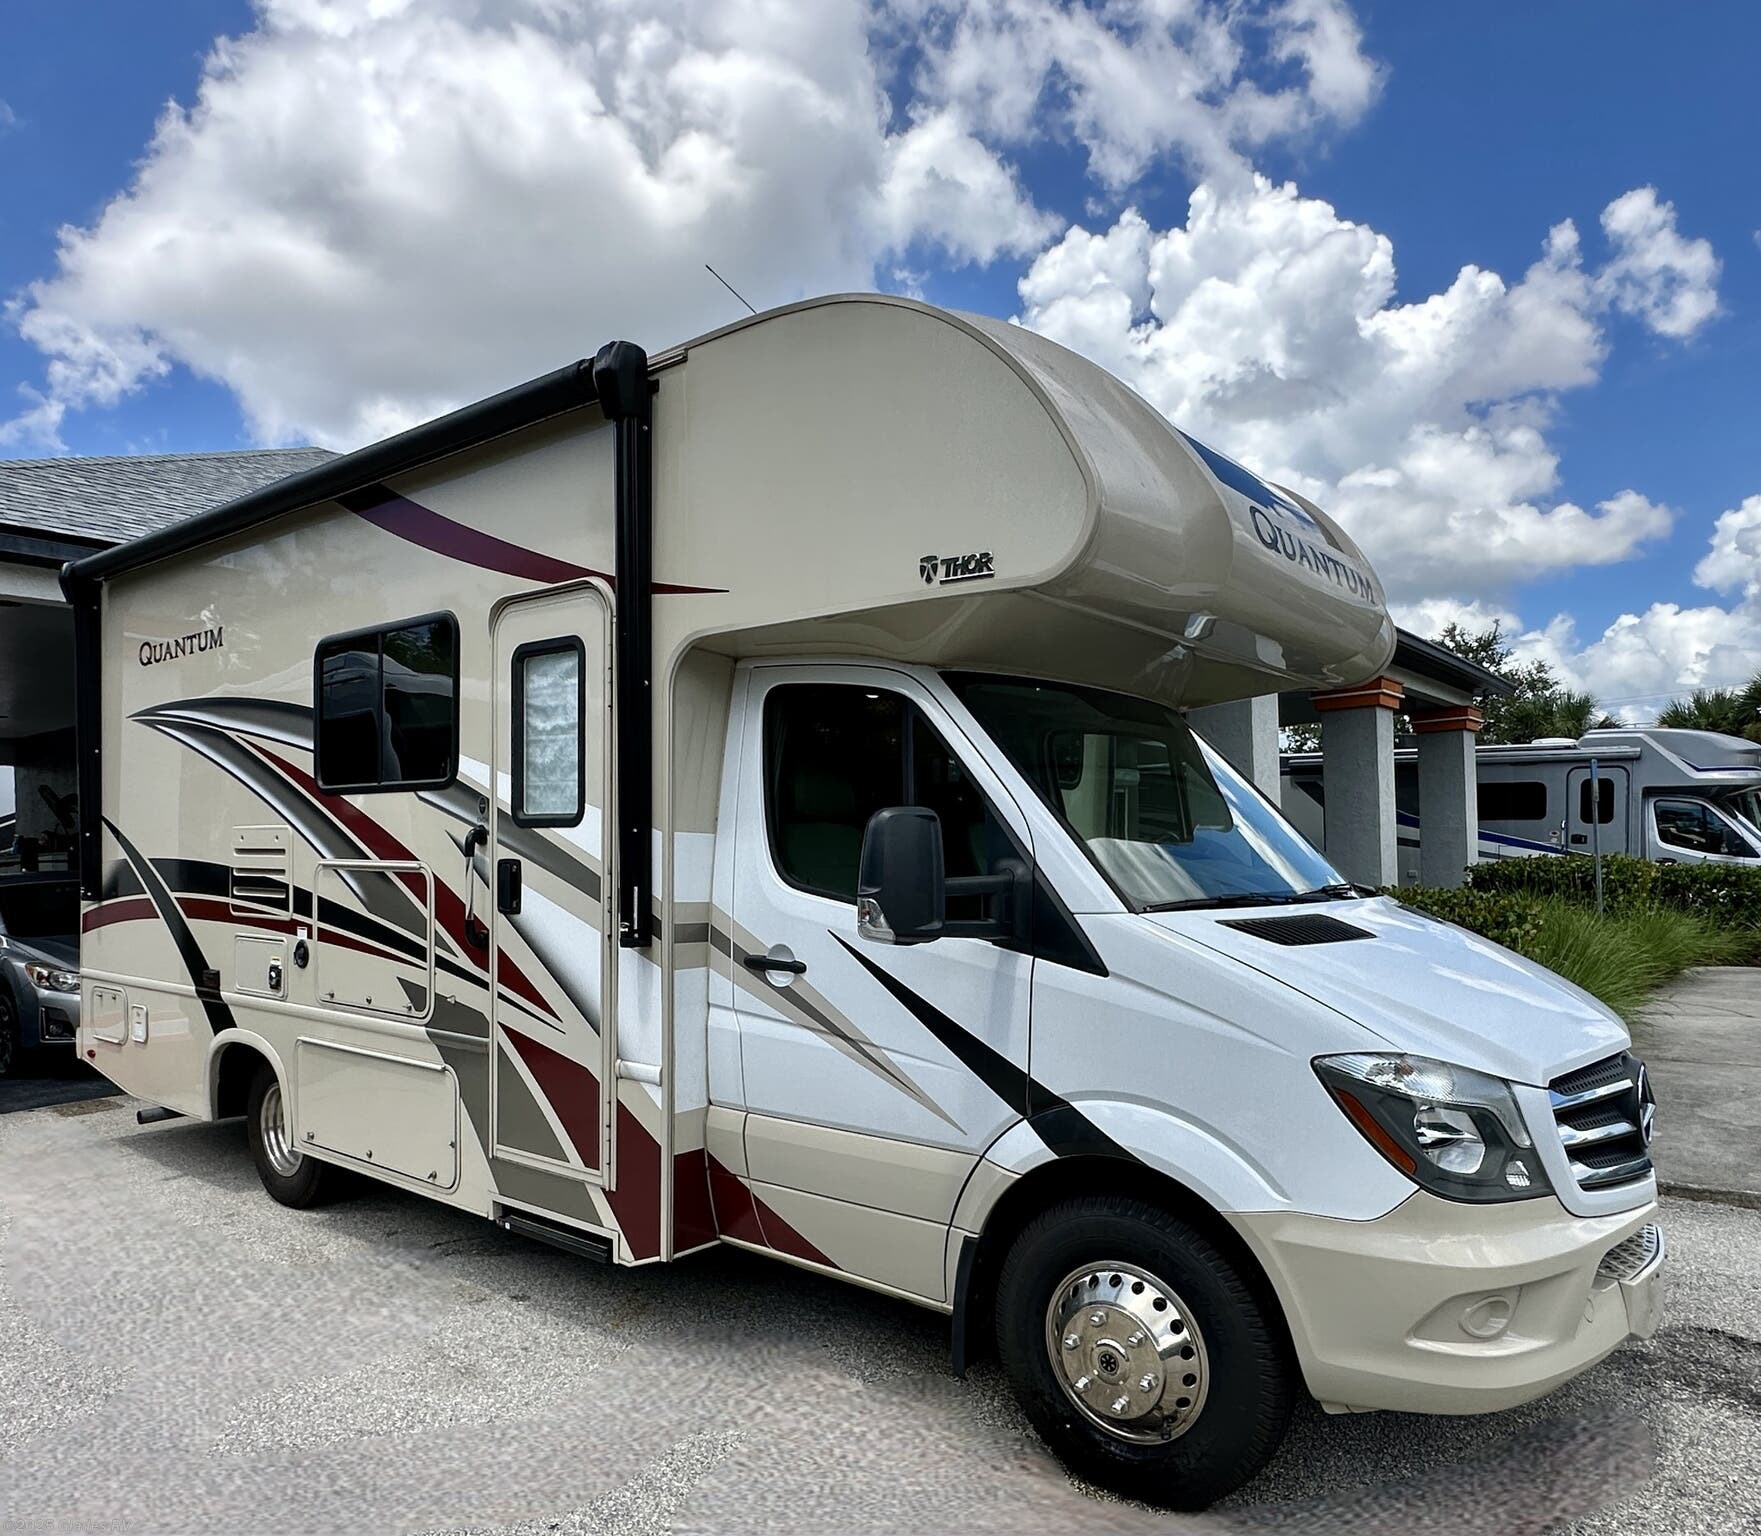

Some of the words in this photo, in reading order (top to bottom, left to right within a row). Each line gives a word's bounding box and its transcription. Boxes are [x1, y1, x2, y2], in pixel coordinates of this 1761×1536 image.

[940, 552, 994, 579] THOR
[1249, 505, 1375, 605] QUANTUM
[139, 626, 224, 667] QUANTUM
